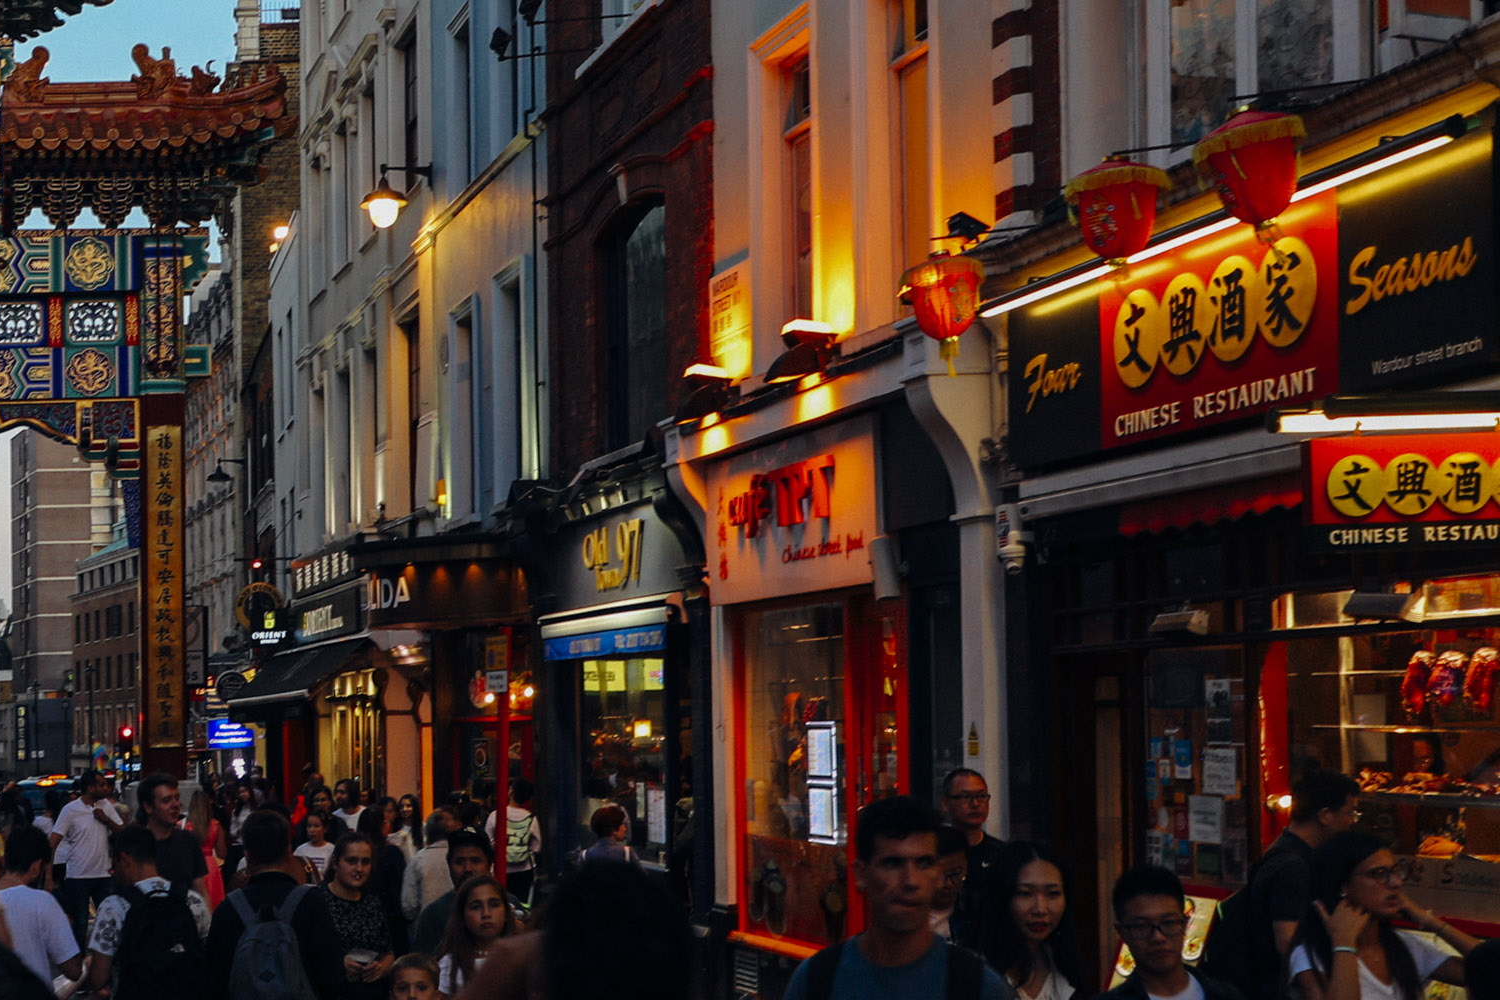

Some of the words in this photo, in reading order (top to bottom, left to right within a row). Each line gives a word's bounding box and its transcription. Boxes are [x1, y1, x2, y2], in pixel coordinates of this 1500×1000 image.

[1345, 236, 1478, 316] Seasons
[1118, 251, 1303, 374] 文興酒家
[1023, 352, 1082, 415] Four
[1371, 353, 1414, 376] Wardour
[1414, 346, 1445, 366] street
[1446, 336, 1483, 358] branch
[1114, 401, 1182, 437] CHINESE
[1193, 367, 1317, 419] RESTAURANT
[1332, 459, 1500, 511] 文興酒
[582, 526, 609, 570] Old
[616, 518, 643, 585] 97
[781, 543, 816, 564] Chinese
[1329, 526, 1410, 546] CHINESE
[1423, 524, 1500, 543] RESTAU
[251, 630, 288, 641] ORIENT
